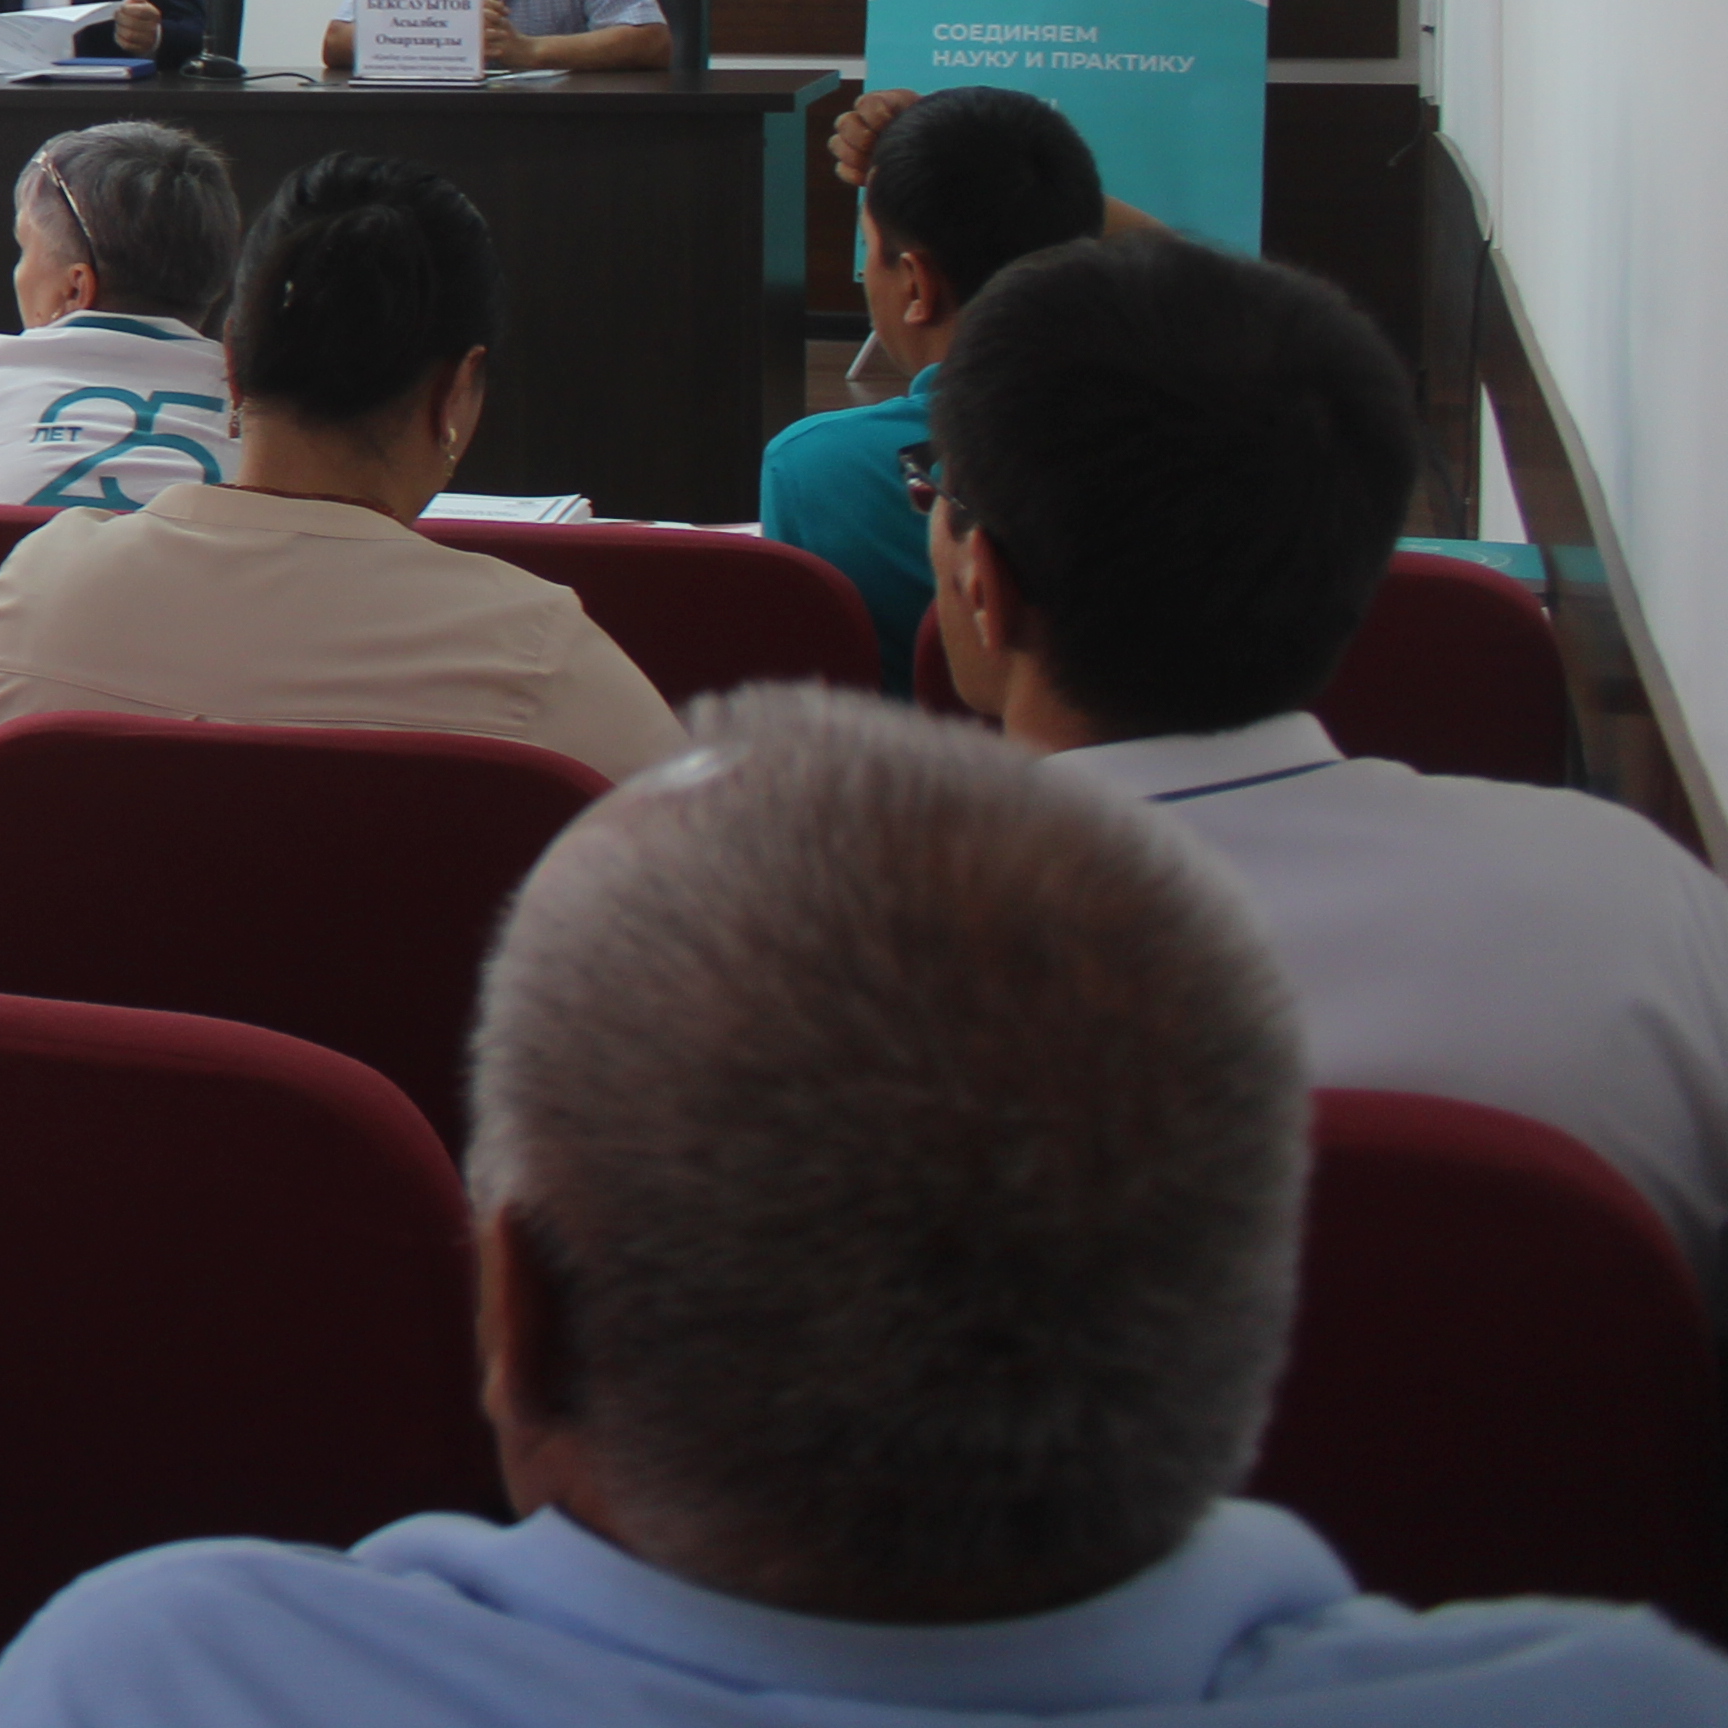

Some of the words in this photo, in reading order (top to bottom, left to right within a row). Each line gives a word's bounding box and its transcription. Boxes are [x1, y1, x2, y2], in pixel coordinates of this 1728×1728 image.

[933, 23, 1099, 43] СОЕДИНЯЕМ
[932, 50, 1019, 69] НАУКУ
[1025, 51, 1045, 68] И
[1051, 52, 1196, 74] ПРАКТИКУ
[29, 426, 83, 443] ЛЕТ
